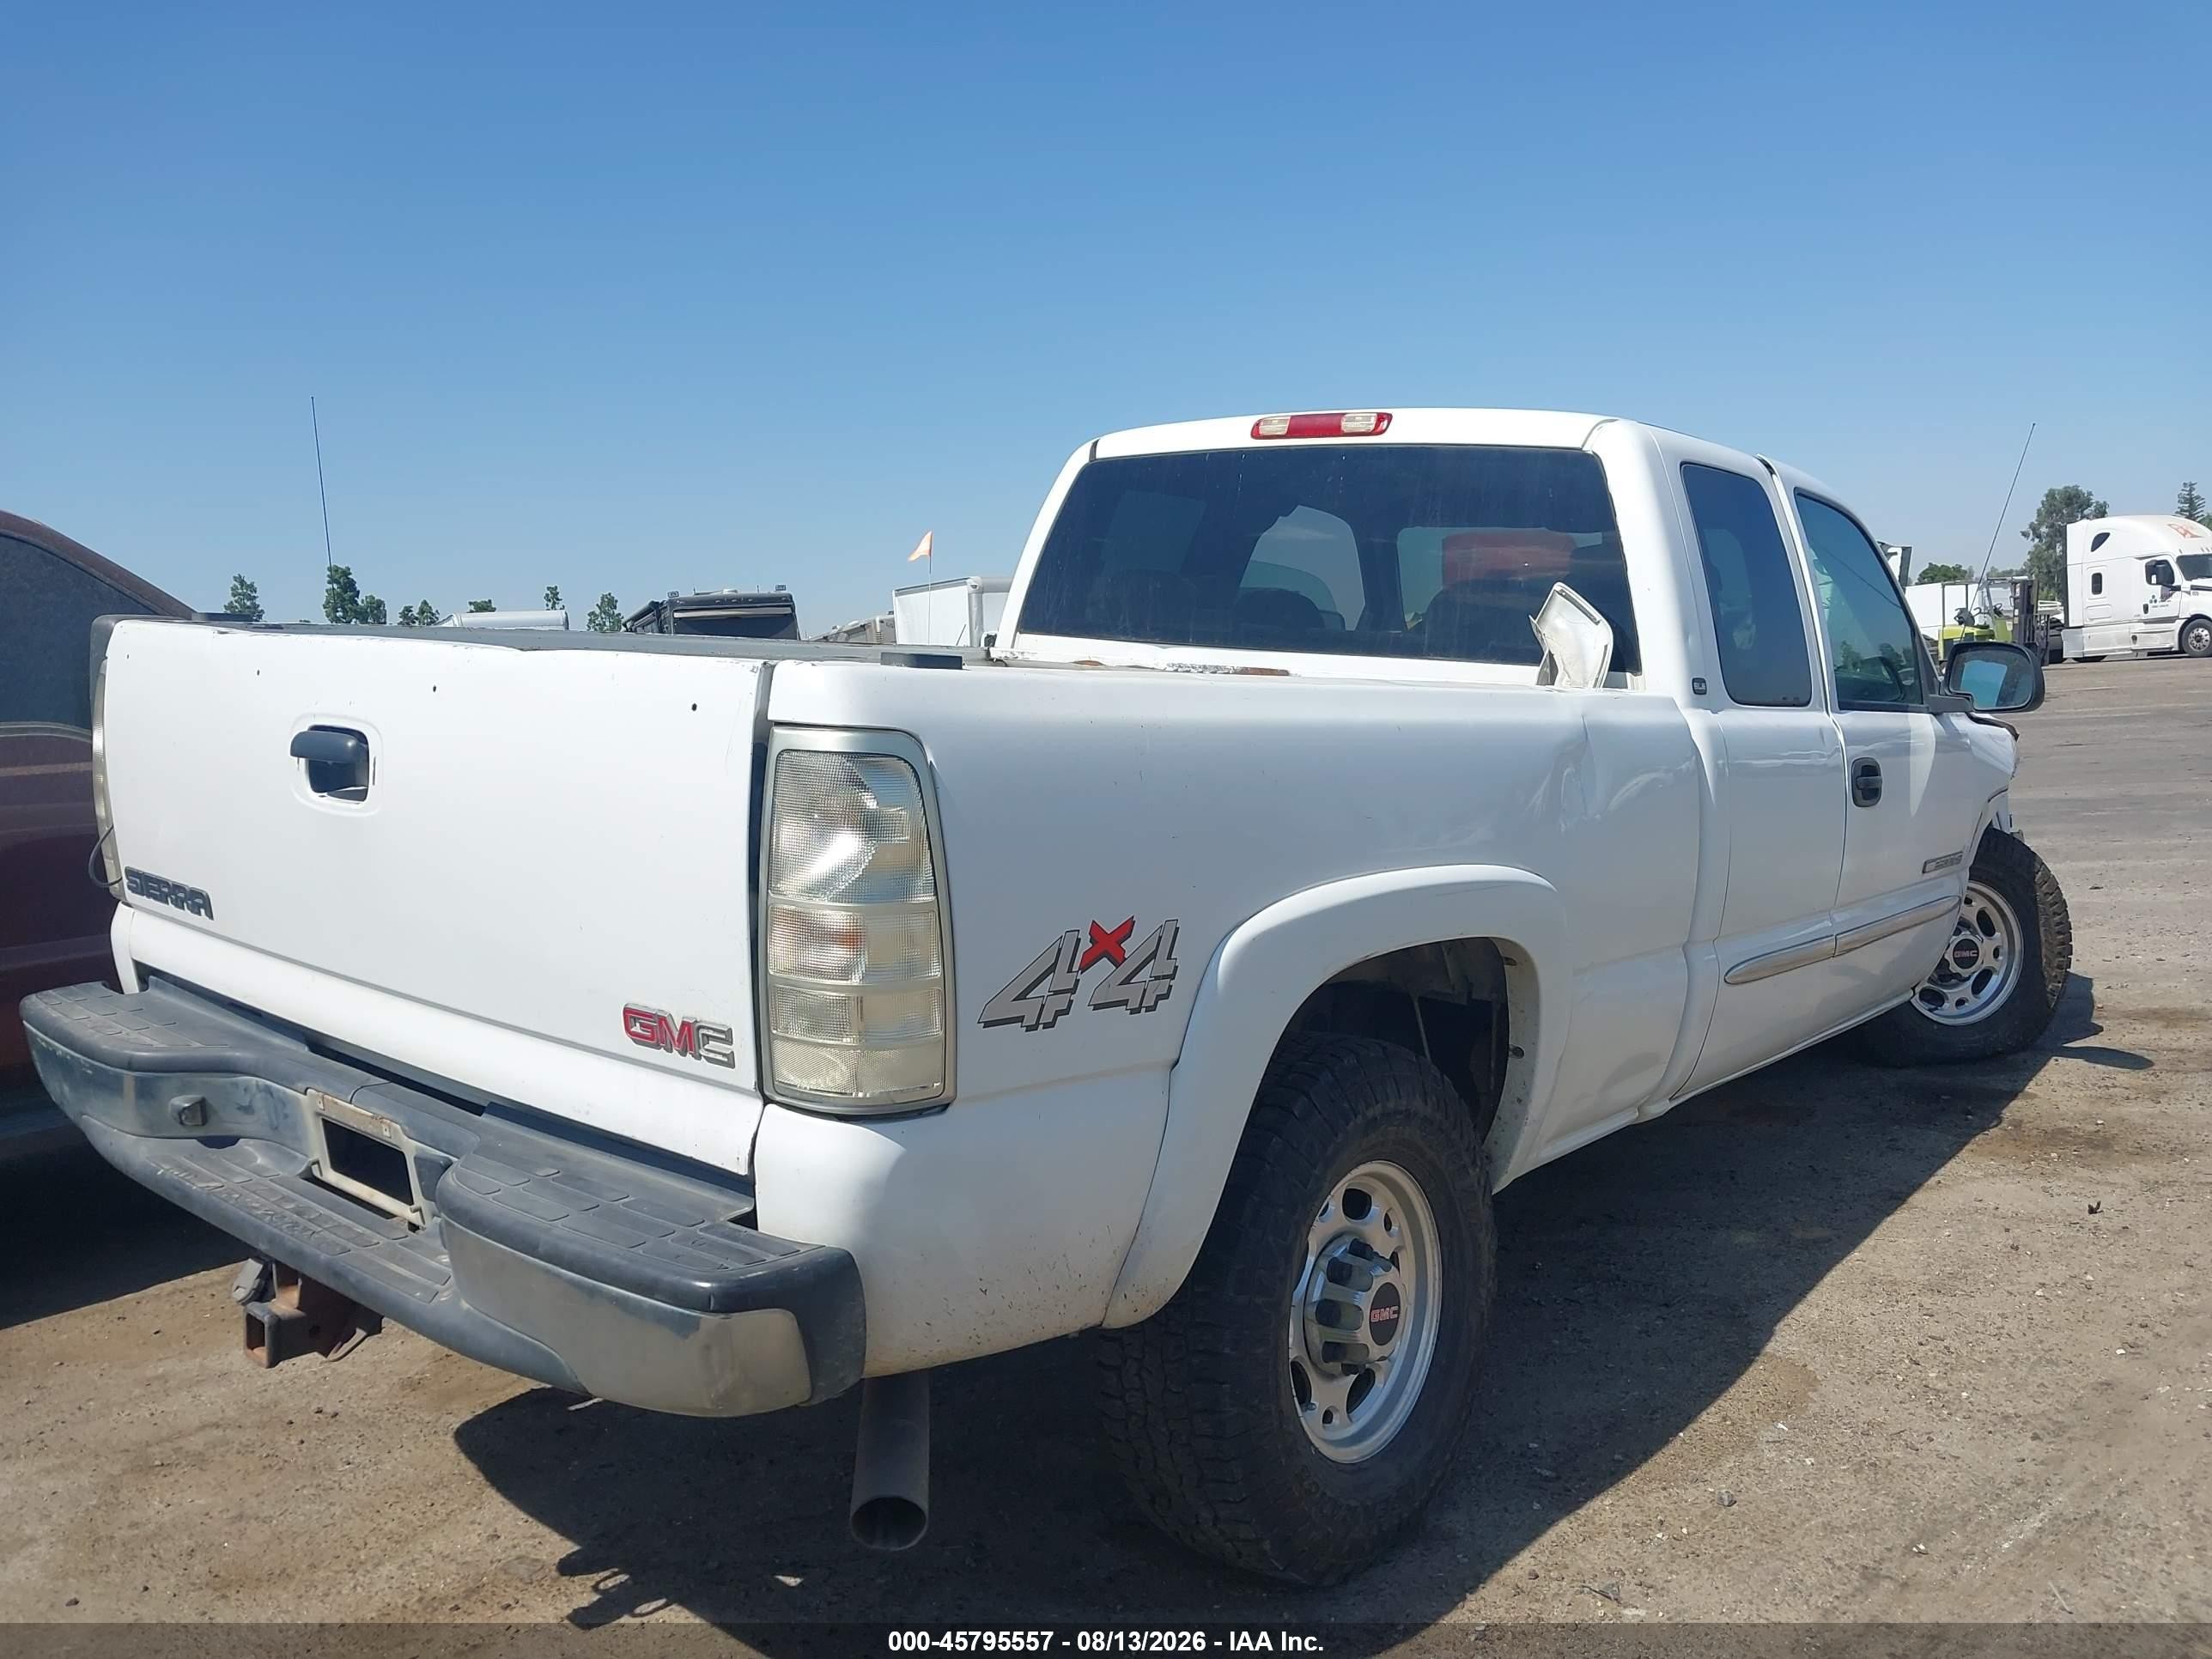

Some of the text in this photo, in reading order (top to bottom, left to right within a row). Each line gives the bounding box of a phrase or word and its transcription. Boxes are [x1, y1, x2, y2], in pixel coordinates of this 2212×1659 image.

[124, 866, 215, 921] SIERRA
[1954, 950, 1978, 958] GMC
[623, 1002, 736, 1069] GMC
[1370, 1305, 1400, 1322] GMC
